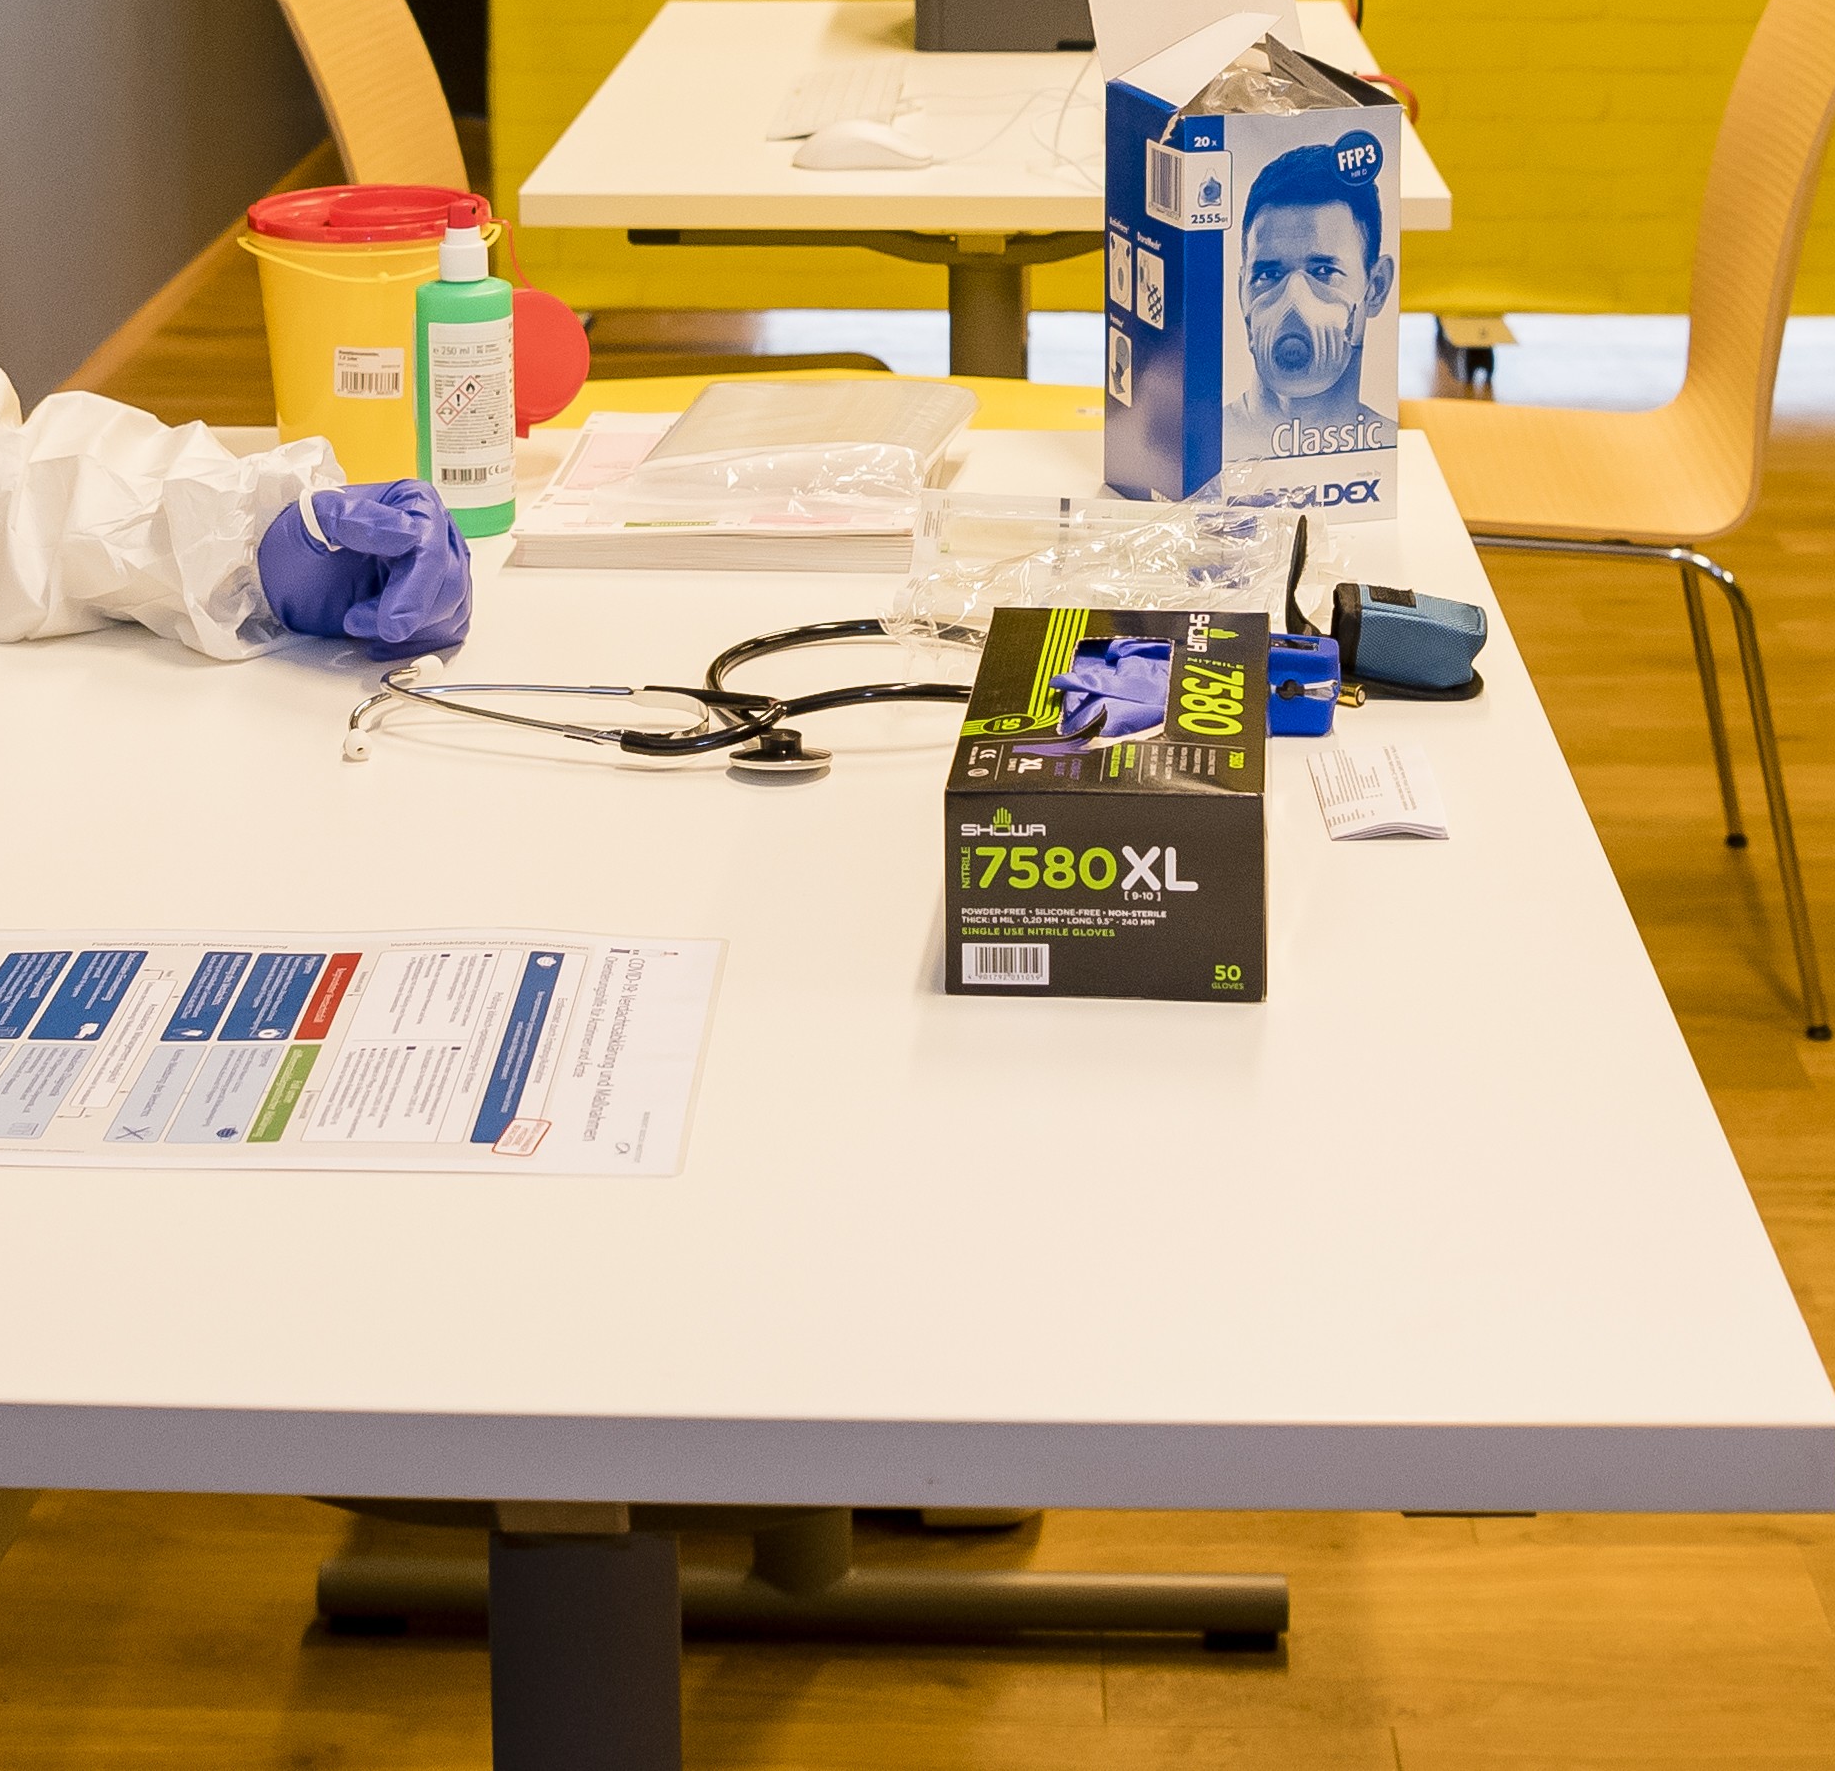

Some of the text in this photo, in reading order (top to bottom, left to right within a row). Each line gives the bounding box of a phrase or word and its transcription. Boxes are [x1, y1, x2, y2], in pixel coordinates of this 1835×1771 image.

[1193, 136, 1210, 148] 20
[1337, 144, 1377, 172] FFP3
[1190, 213, 1221, 224] 2555
[441, 346, 457, 356] 250
[459, 346, 470, 355] ml
[1271, 414, 1383, 458] Classic
[1187, 613, 1211, 653] SHOWA
[1177, 664, 1245, 736] 7580
[1018, 758, 1043, 774] XL
[960, 823, 1047, 837] SHOWA
[961, 845, 971, 890] NITRILE
[961, 907, 1167, 918] POWDER-FREE SILICONE-FREE NON-STERILE
[1121, 918, 1138, 926] 240
[1140, 918, 1155, 926] MM
[961, 927, 1115, 937] SINGLE USE NITRILE GLOVES
[1214, 964, 1242, 981] 50
[1211, 982, 1245, 990] GLOVES
